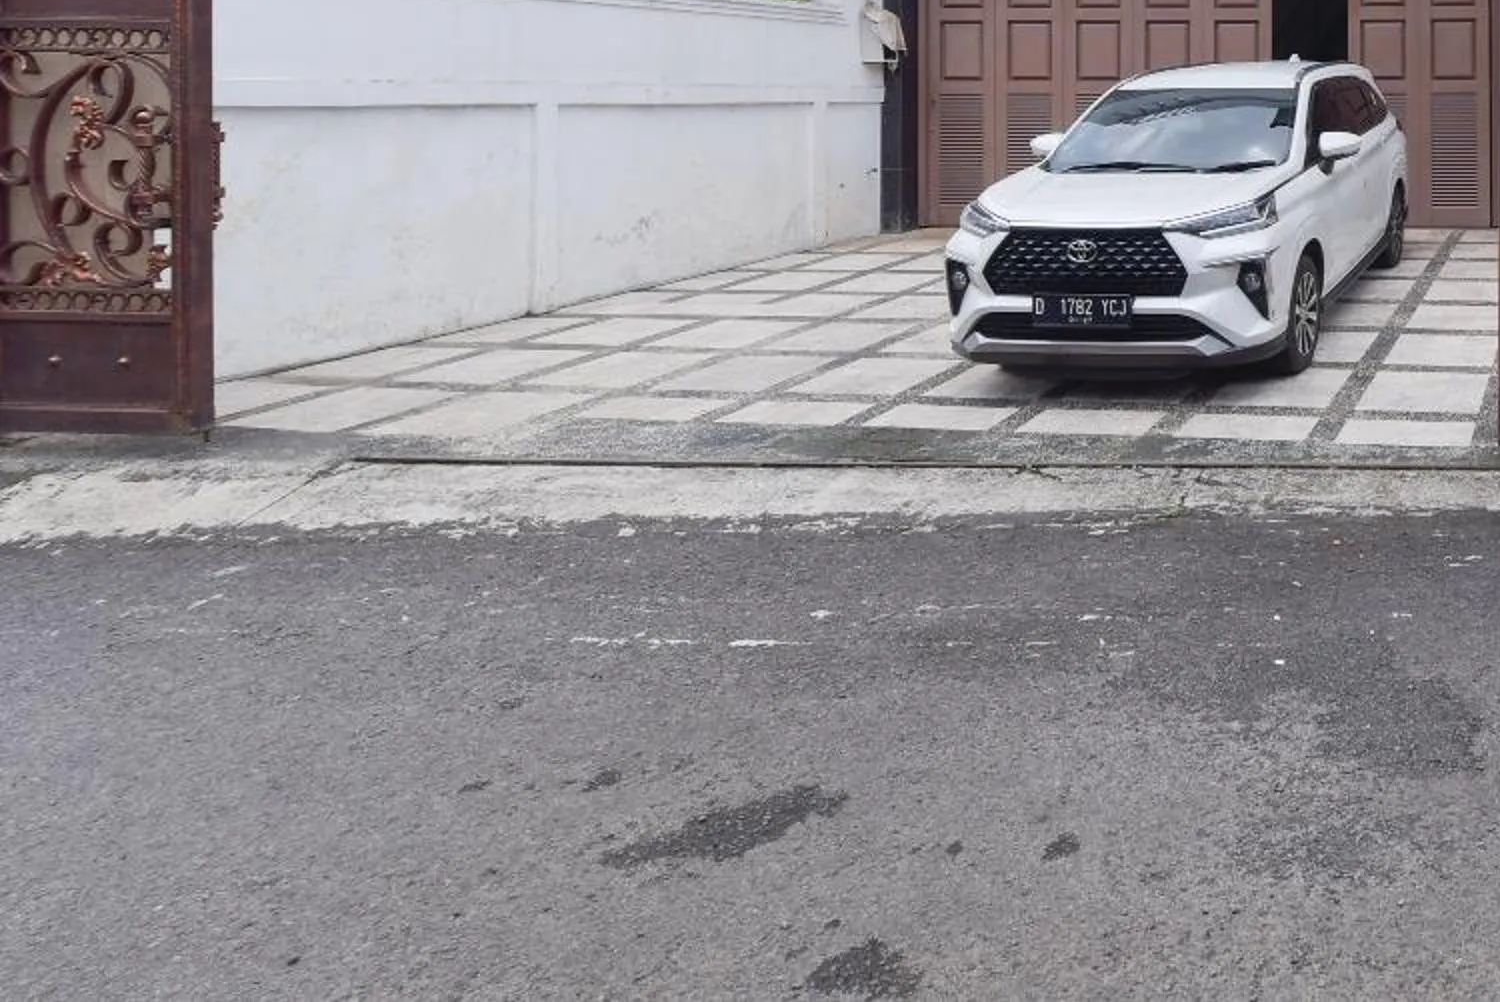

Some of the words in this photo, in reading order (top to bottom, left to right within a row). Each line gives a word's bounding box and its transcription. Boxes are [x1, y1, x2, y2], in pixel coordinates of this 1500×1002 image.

[1035, 297, 1045, 316] D
[1061, 297, 1093, 316] 1782
[1101, 298, 1127, 317] YCJ
